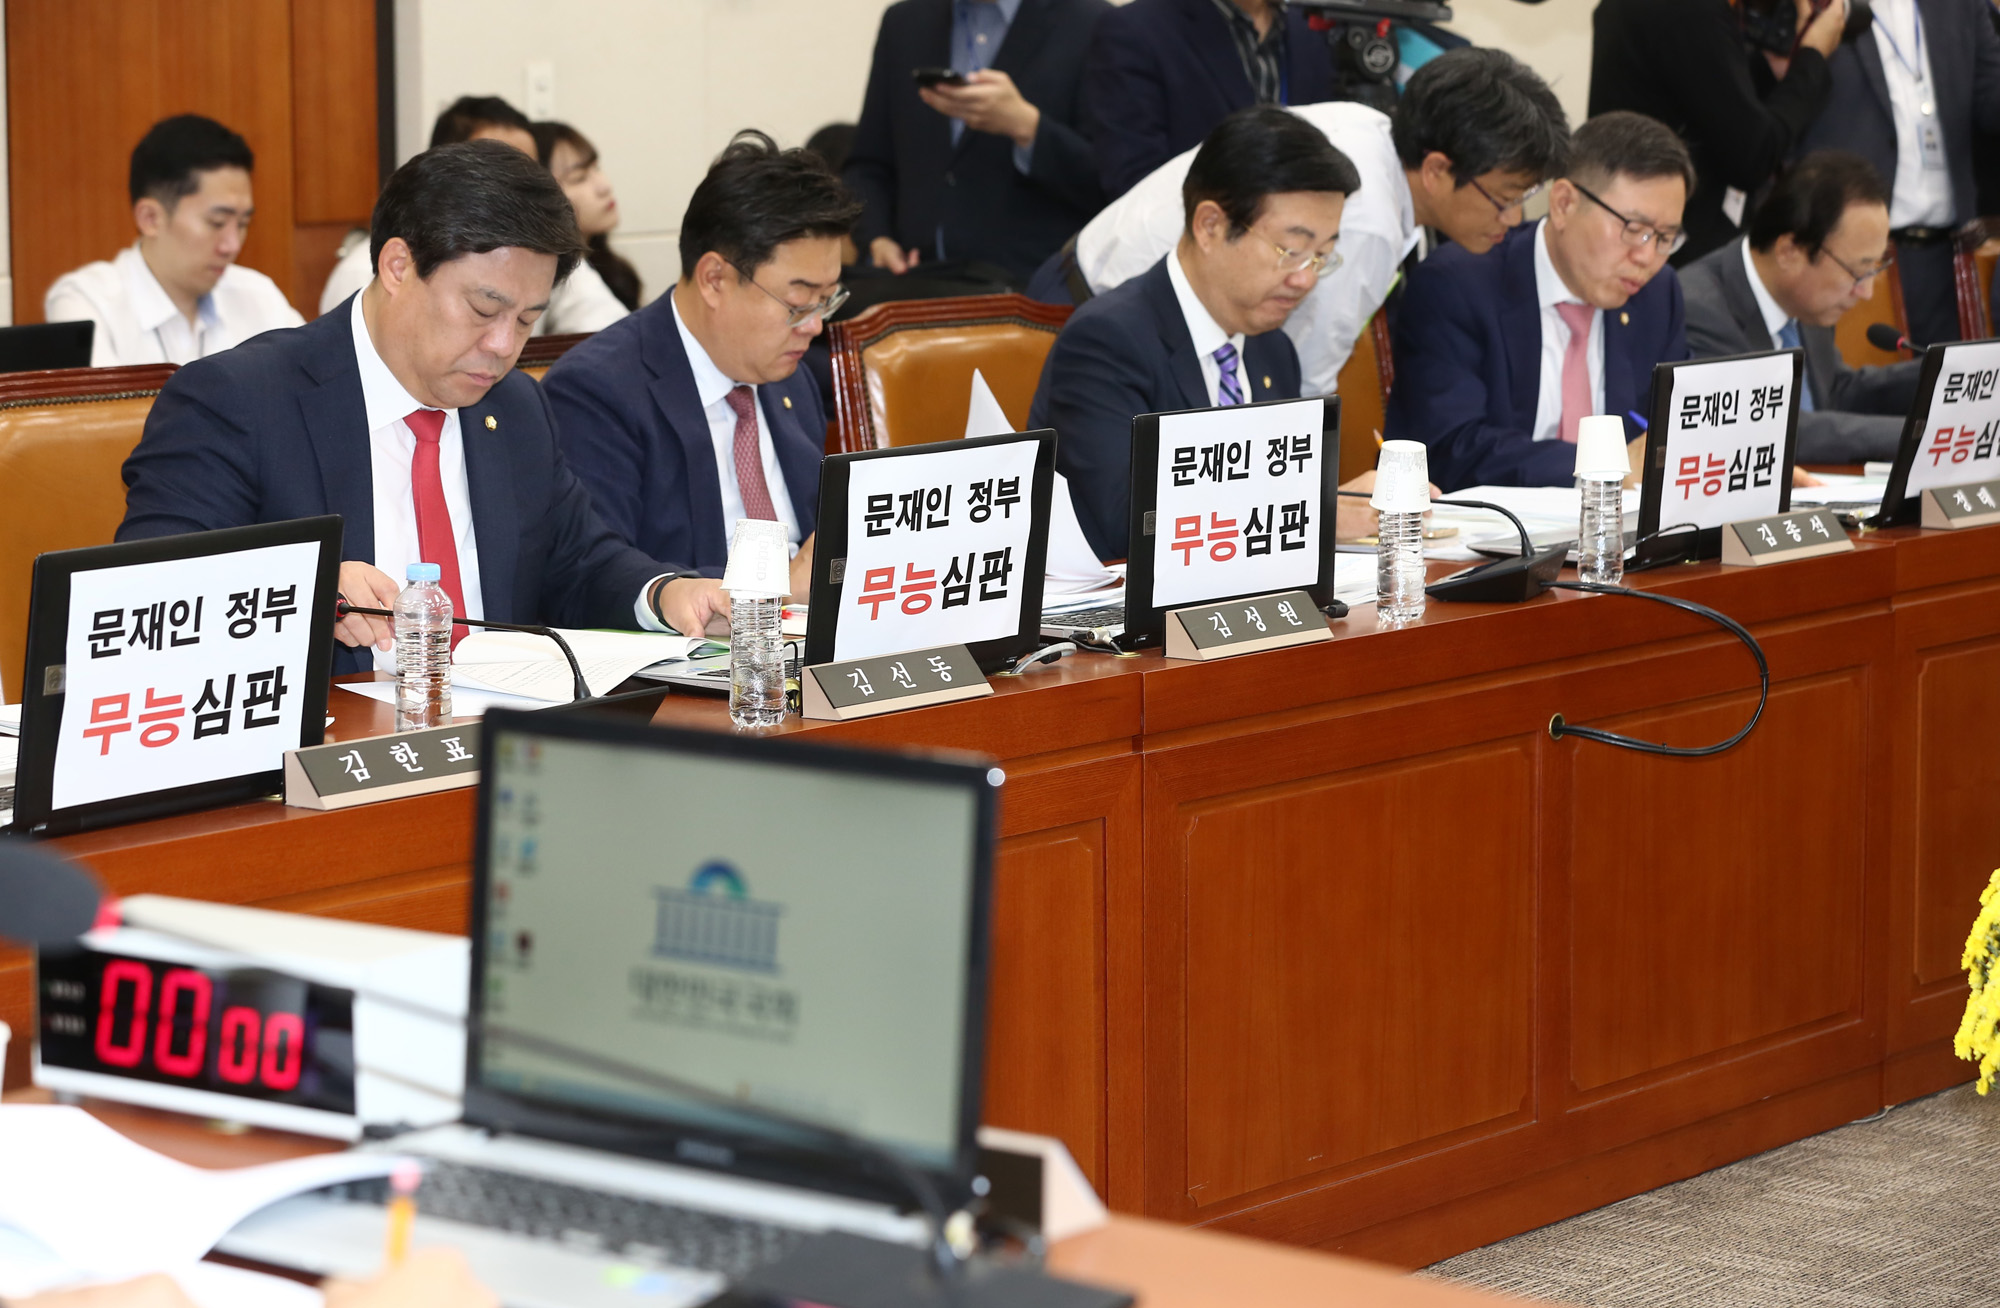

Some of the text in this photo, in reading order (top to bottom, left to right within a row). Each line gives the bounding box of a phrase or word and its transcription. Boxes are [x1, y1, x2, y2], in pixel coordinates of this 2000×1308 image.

[1680, 385, 1784, 430] 문재인 정부
[1943, 369, 1999, 404] 문재인
[1172, 434, 1312, 487] 문재인 정부
[1675, 443, 1775, 500] 무능심판
[1928, 420, 2000, 466] 무능심
[865, 476, 1020, 538] 문재인 정부
[1172, 500, 1309, 567] 무능심판
[857, 547, 1013, 621] 무능심판
[88, 584, 298, 659] 문재인 정부
[83, 666, 288, 757] 무능심판
